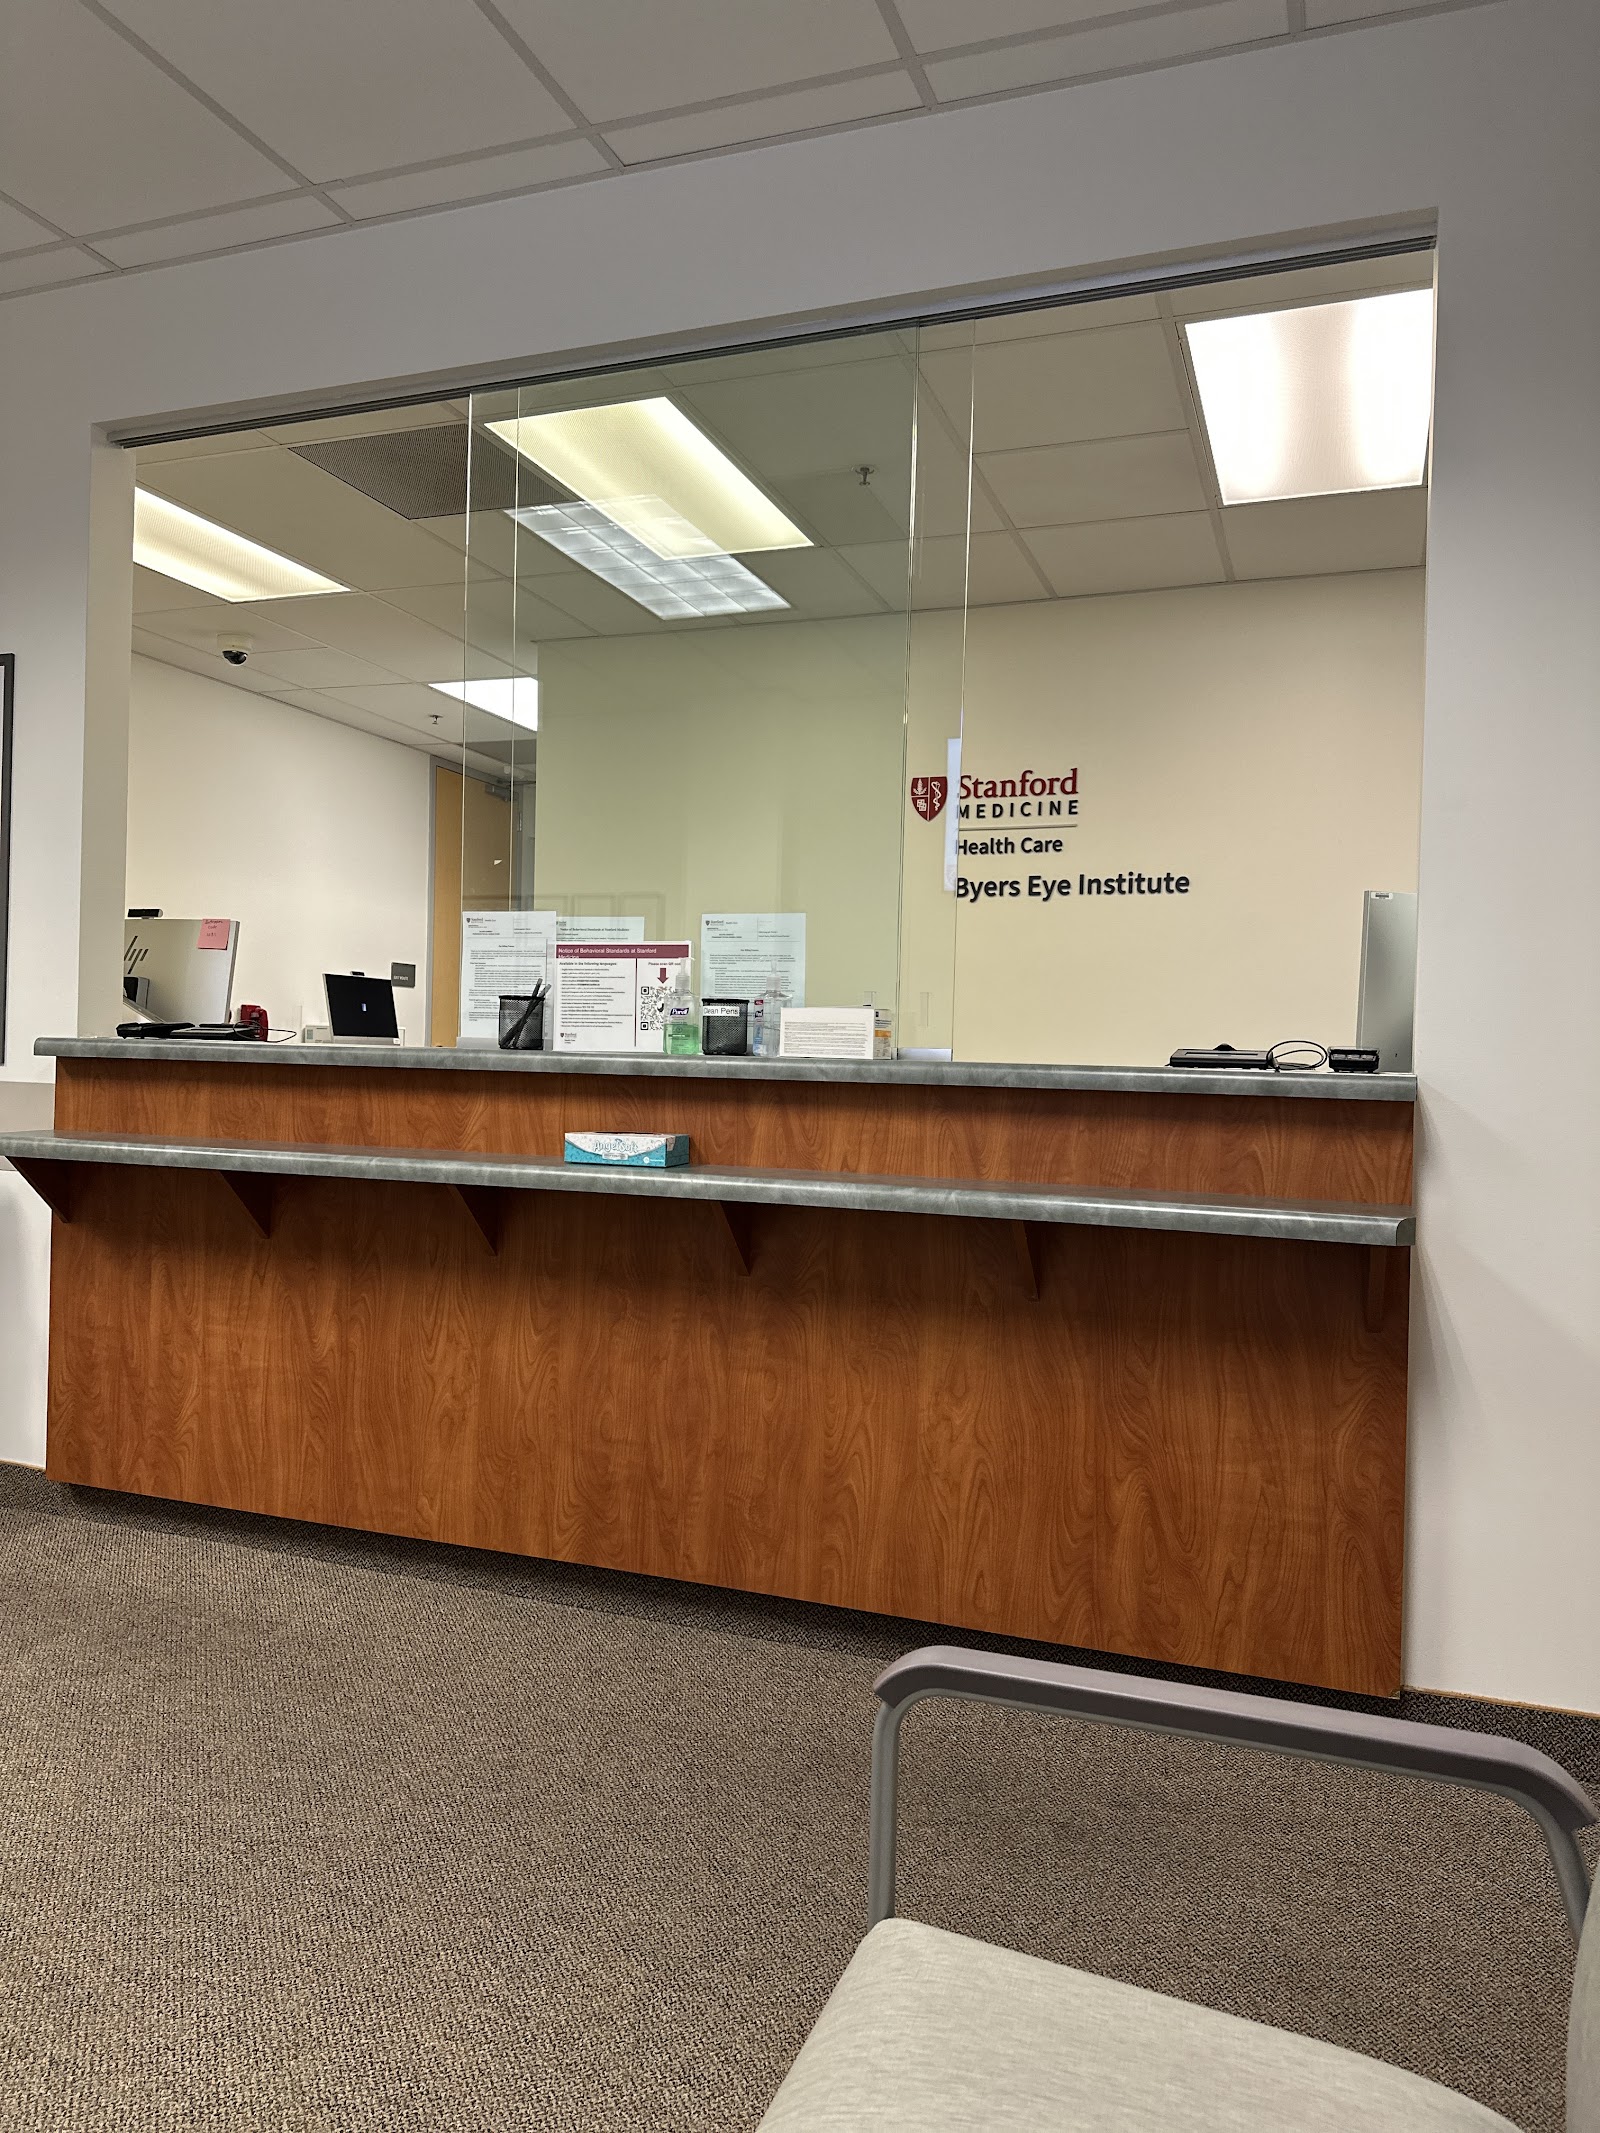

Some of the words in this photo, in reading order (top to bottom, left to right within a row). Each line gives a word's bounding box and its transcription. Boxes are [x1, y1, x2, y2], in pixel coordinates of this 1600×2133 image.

[960, 767, 1079, 800] Stanford
[957, 799, 1079, 819] MEDICINE
[956, 837, 1015, 855] Health
[1021, 837, 1063, 853] Care
[956, 877, 1021, 903] Byers
[1028, 875, 1071, 902] Eye
[1079, 872, 1190, 896] Institute
